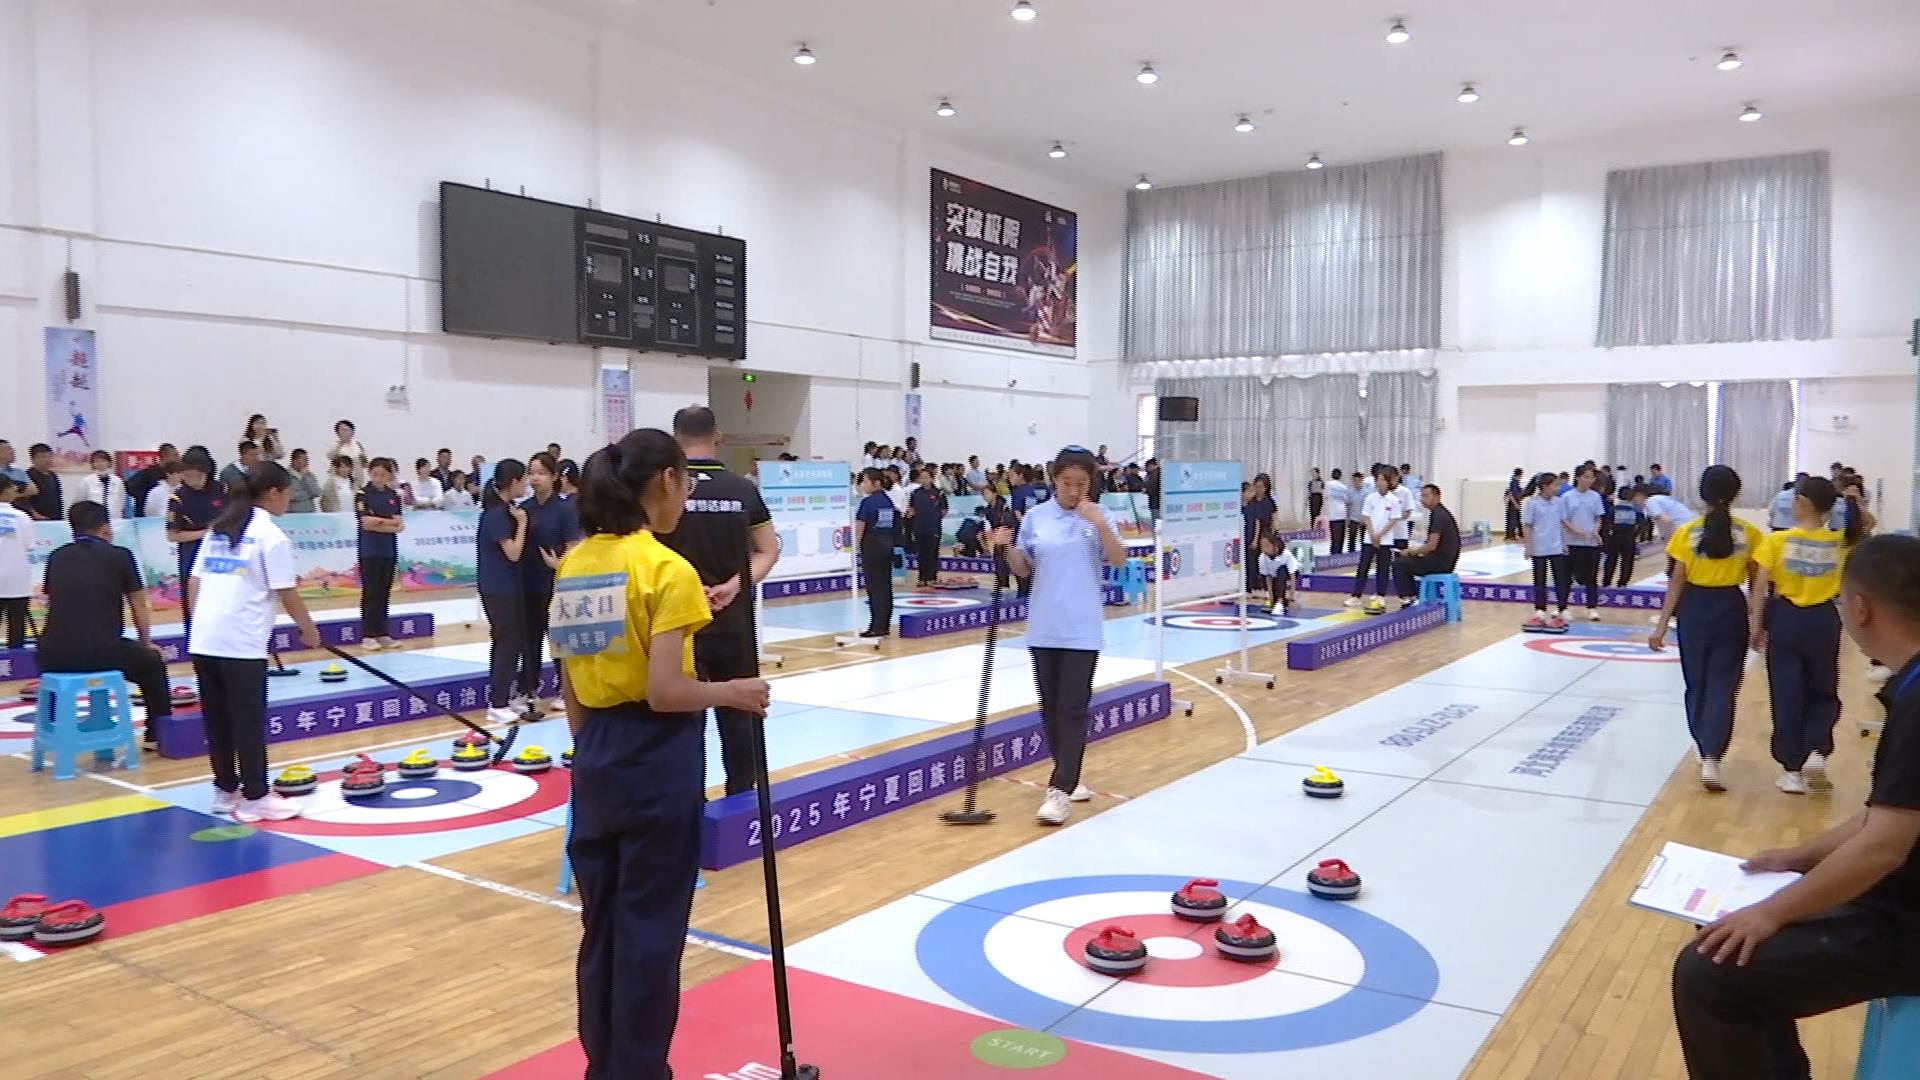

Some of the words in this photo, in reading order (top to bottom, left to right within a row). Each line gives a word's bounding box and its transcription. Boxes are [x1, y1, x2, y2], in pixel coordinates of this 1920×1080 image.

[946, 201, 1021, 250] 突破极限
[945, 240, 1020, 287] 挑战自我
[555, 594, 614, 621] 大武口
[986, 1037, 1052, 1060] START
